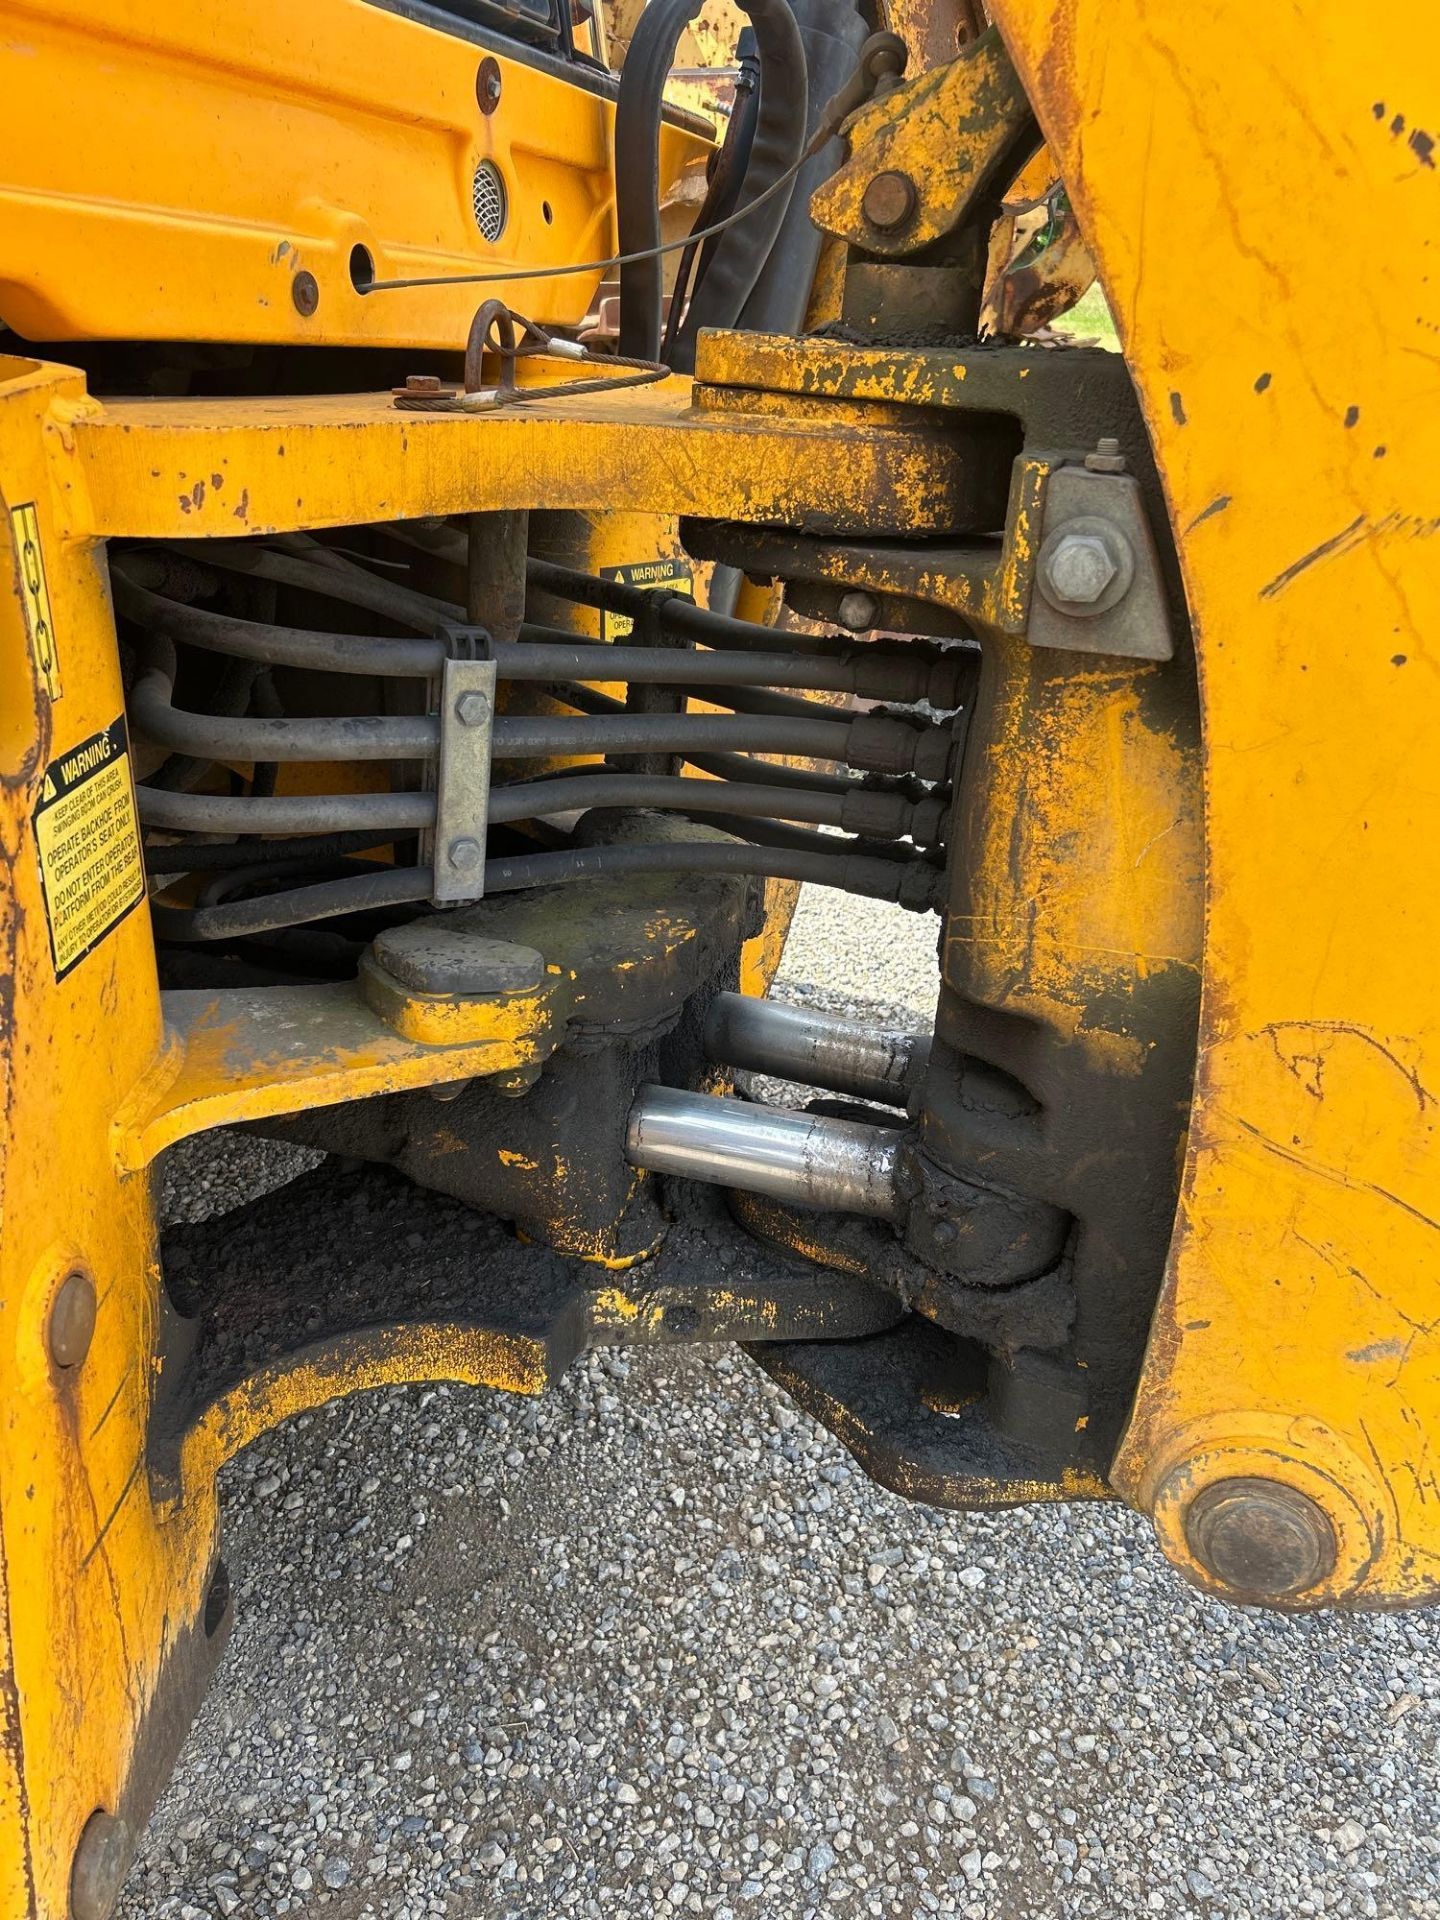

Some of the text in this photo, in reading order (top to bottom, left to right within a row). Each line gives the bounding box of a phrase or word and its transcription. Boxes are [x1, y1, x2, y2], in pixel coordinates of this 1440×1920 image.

[631, 564, 673, 581] WARNING
[61, 737, 110, 785] WARNING
[53, 809, 80, 836] SWINGING
[80, 798, 95, 816] BOOM
[96, 790, 106, 804] CAN
[54, 768, 118, 821] KEEP CLEAR OF THIS AREA
[47, 792, 129, 868] OPERATE BACKHOE FROM
[54, 839, 97, 882] OPERATOR'S
[99, 824, 115, 846] SEAT
[53, 889, 90, 930] PLATFORM
[91, 871, 110, 897] FROM
[110, 860, 123, 878] THE
[54, 890, 65, 909] DO
[65, 877, 81, 900] NOT
[82, 858, 104, 886] ENTER
[57, 935, 67, 951] ANY
[68, 918, 85, 940] OTHER
[107, 884, 122, 904] COULD
[78, 933, 85, 945] TO
[111, 901, 118, 913] OR
